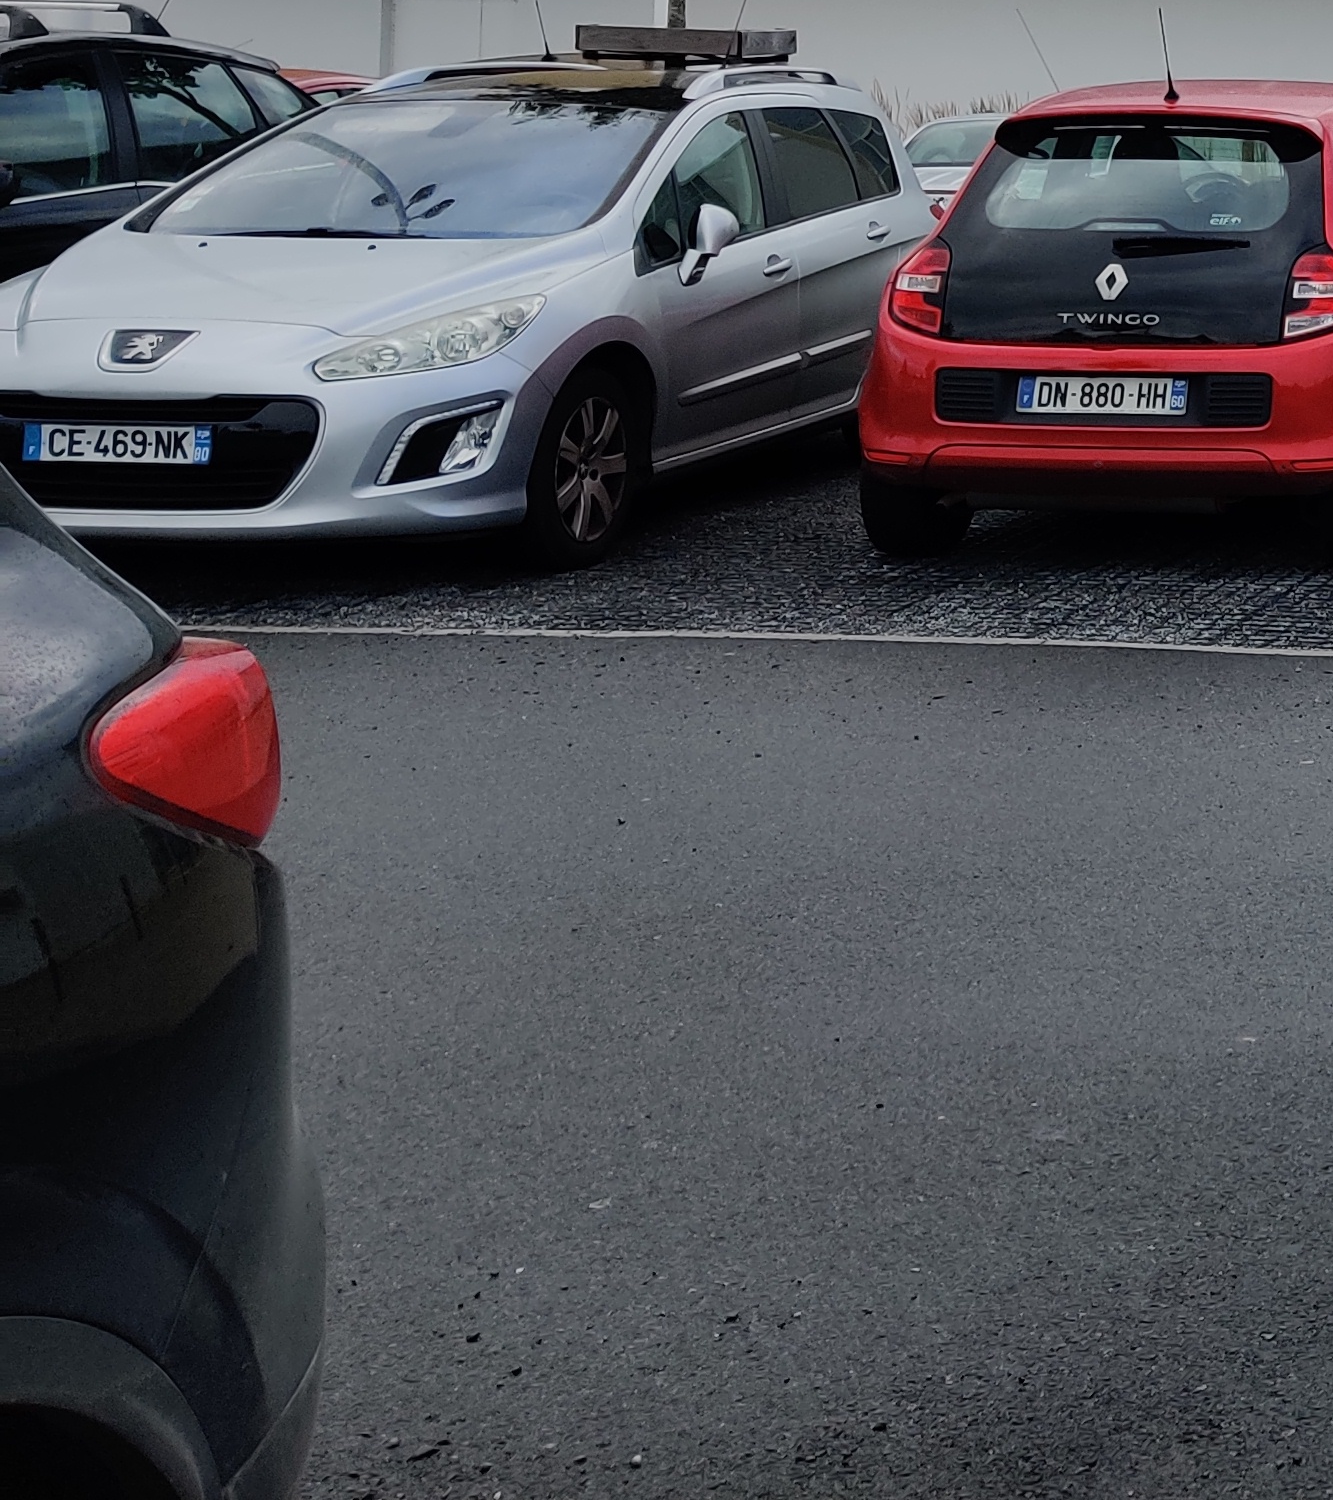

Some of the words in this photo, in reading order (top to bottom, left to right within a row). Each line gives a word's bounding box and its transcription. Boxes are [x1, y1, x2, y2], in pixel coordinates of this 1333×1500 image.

[1057, 313, 1160, 326] TWINGO
[1023, 394, 1030, 404] F
[1037, 381, 1168, 409] DN-880-HH
[1171, 395, 1185, 408] 60
[28, 445, 36, 455] F
[48, 428, 190, 460] CE-469-NK
